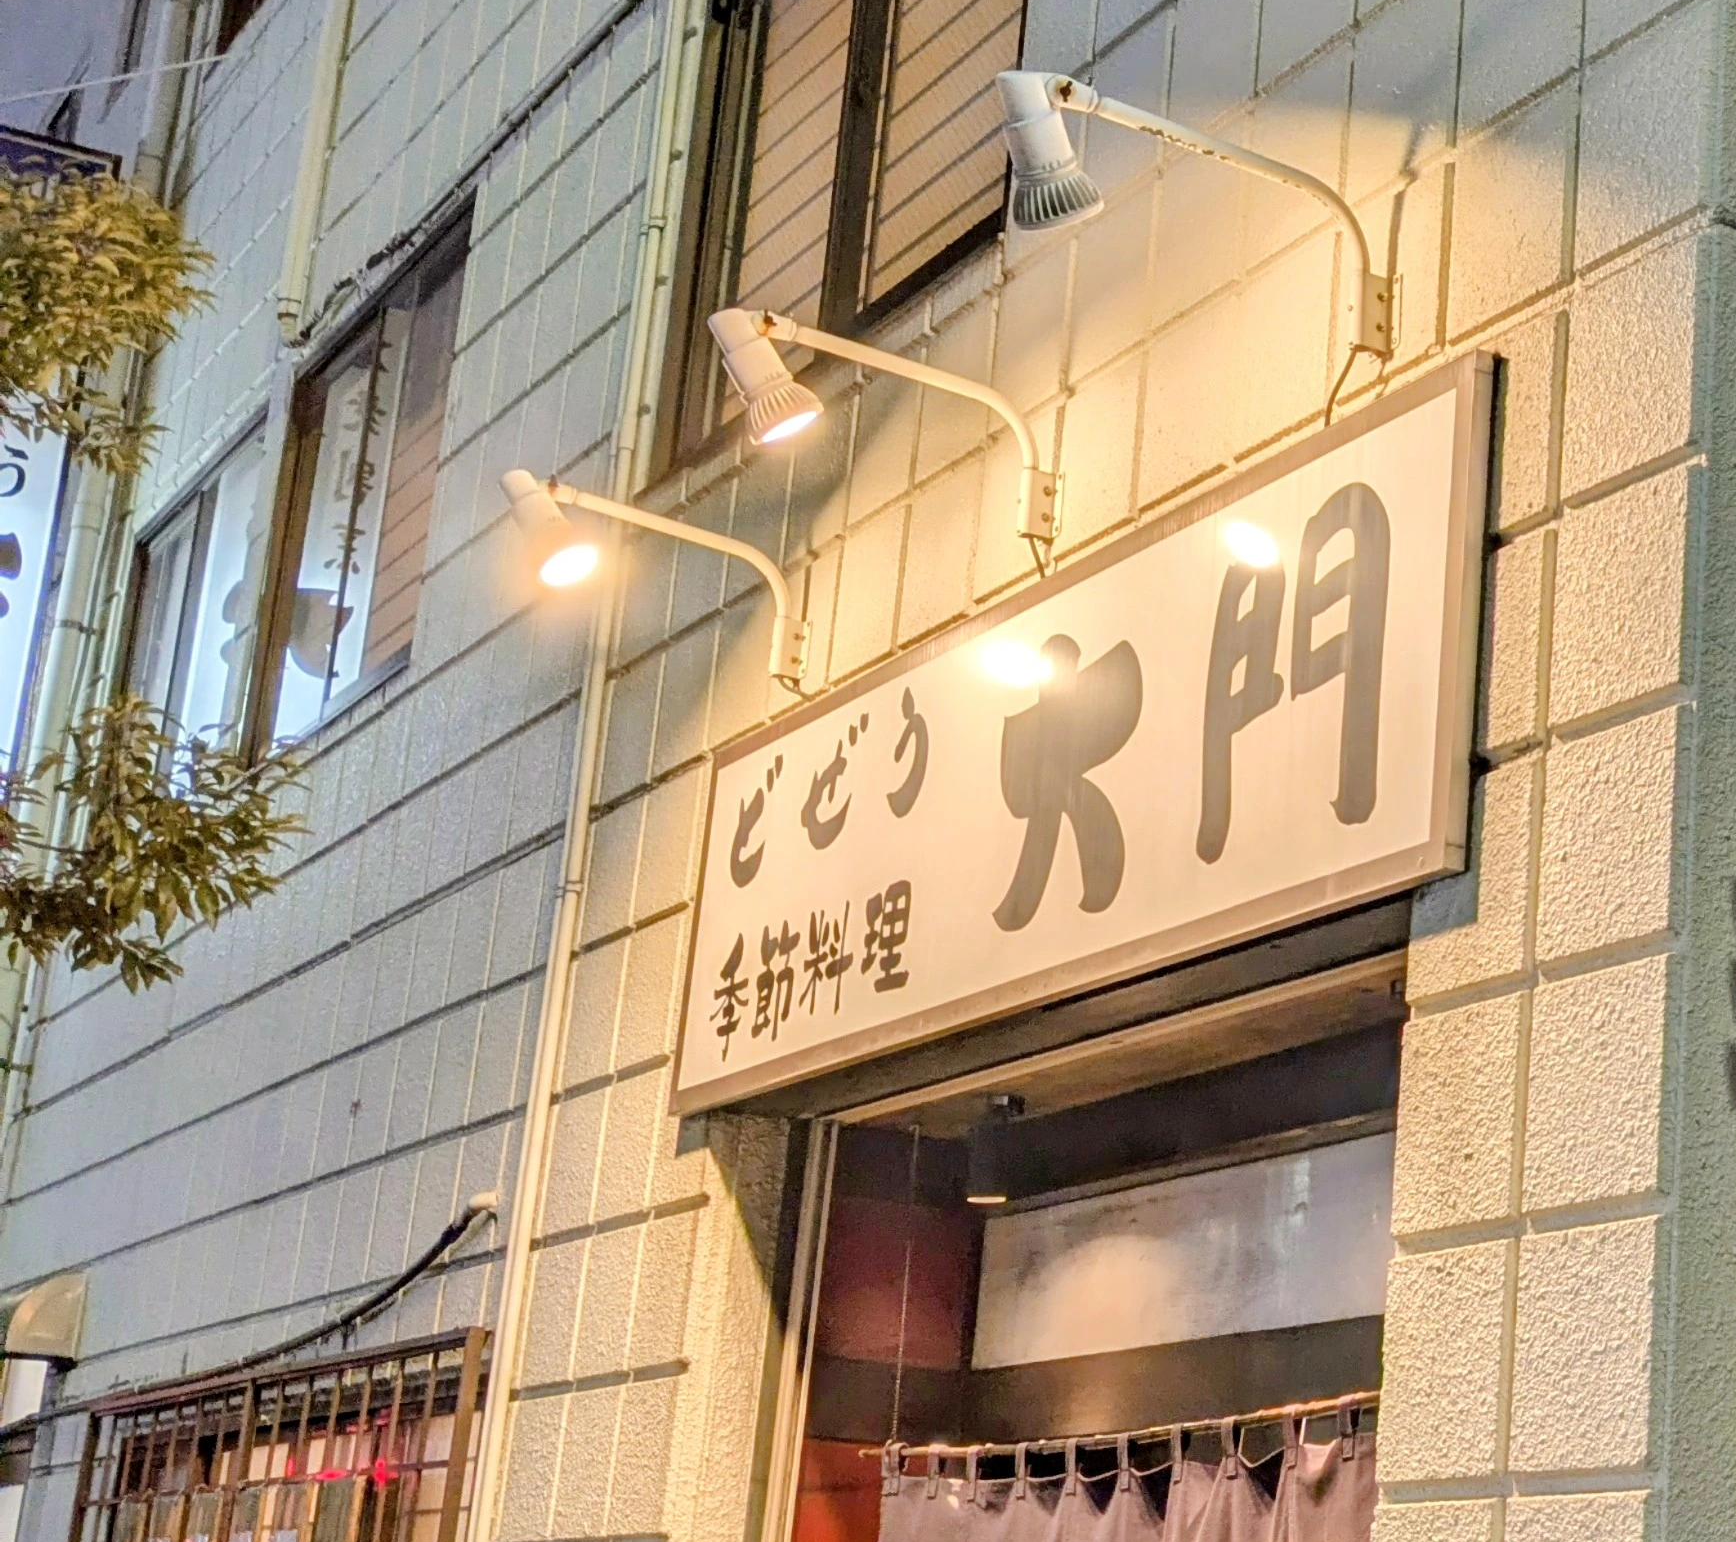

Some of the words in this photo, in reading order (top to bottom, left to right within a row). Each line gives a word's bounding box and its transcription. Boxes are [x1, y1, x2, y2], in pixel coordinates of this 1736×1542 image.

[730, 688, 930, 888] どぜう
[990, 481, 1393, 933] 大門
[709, 879, 913, 1063] 季節料理
